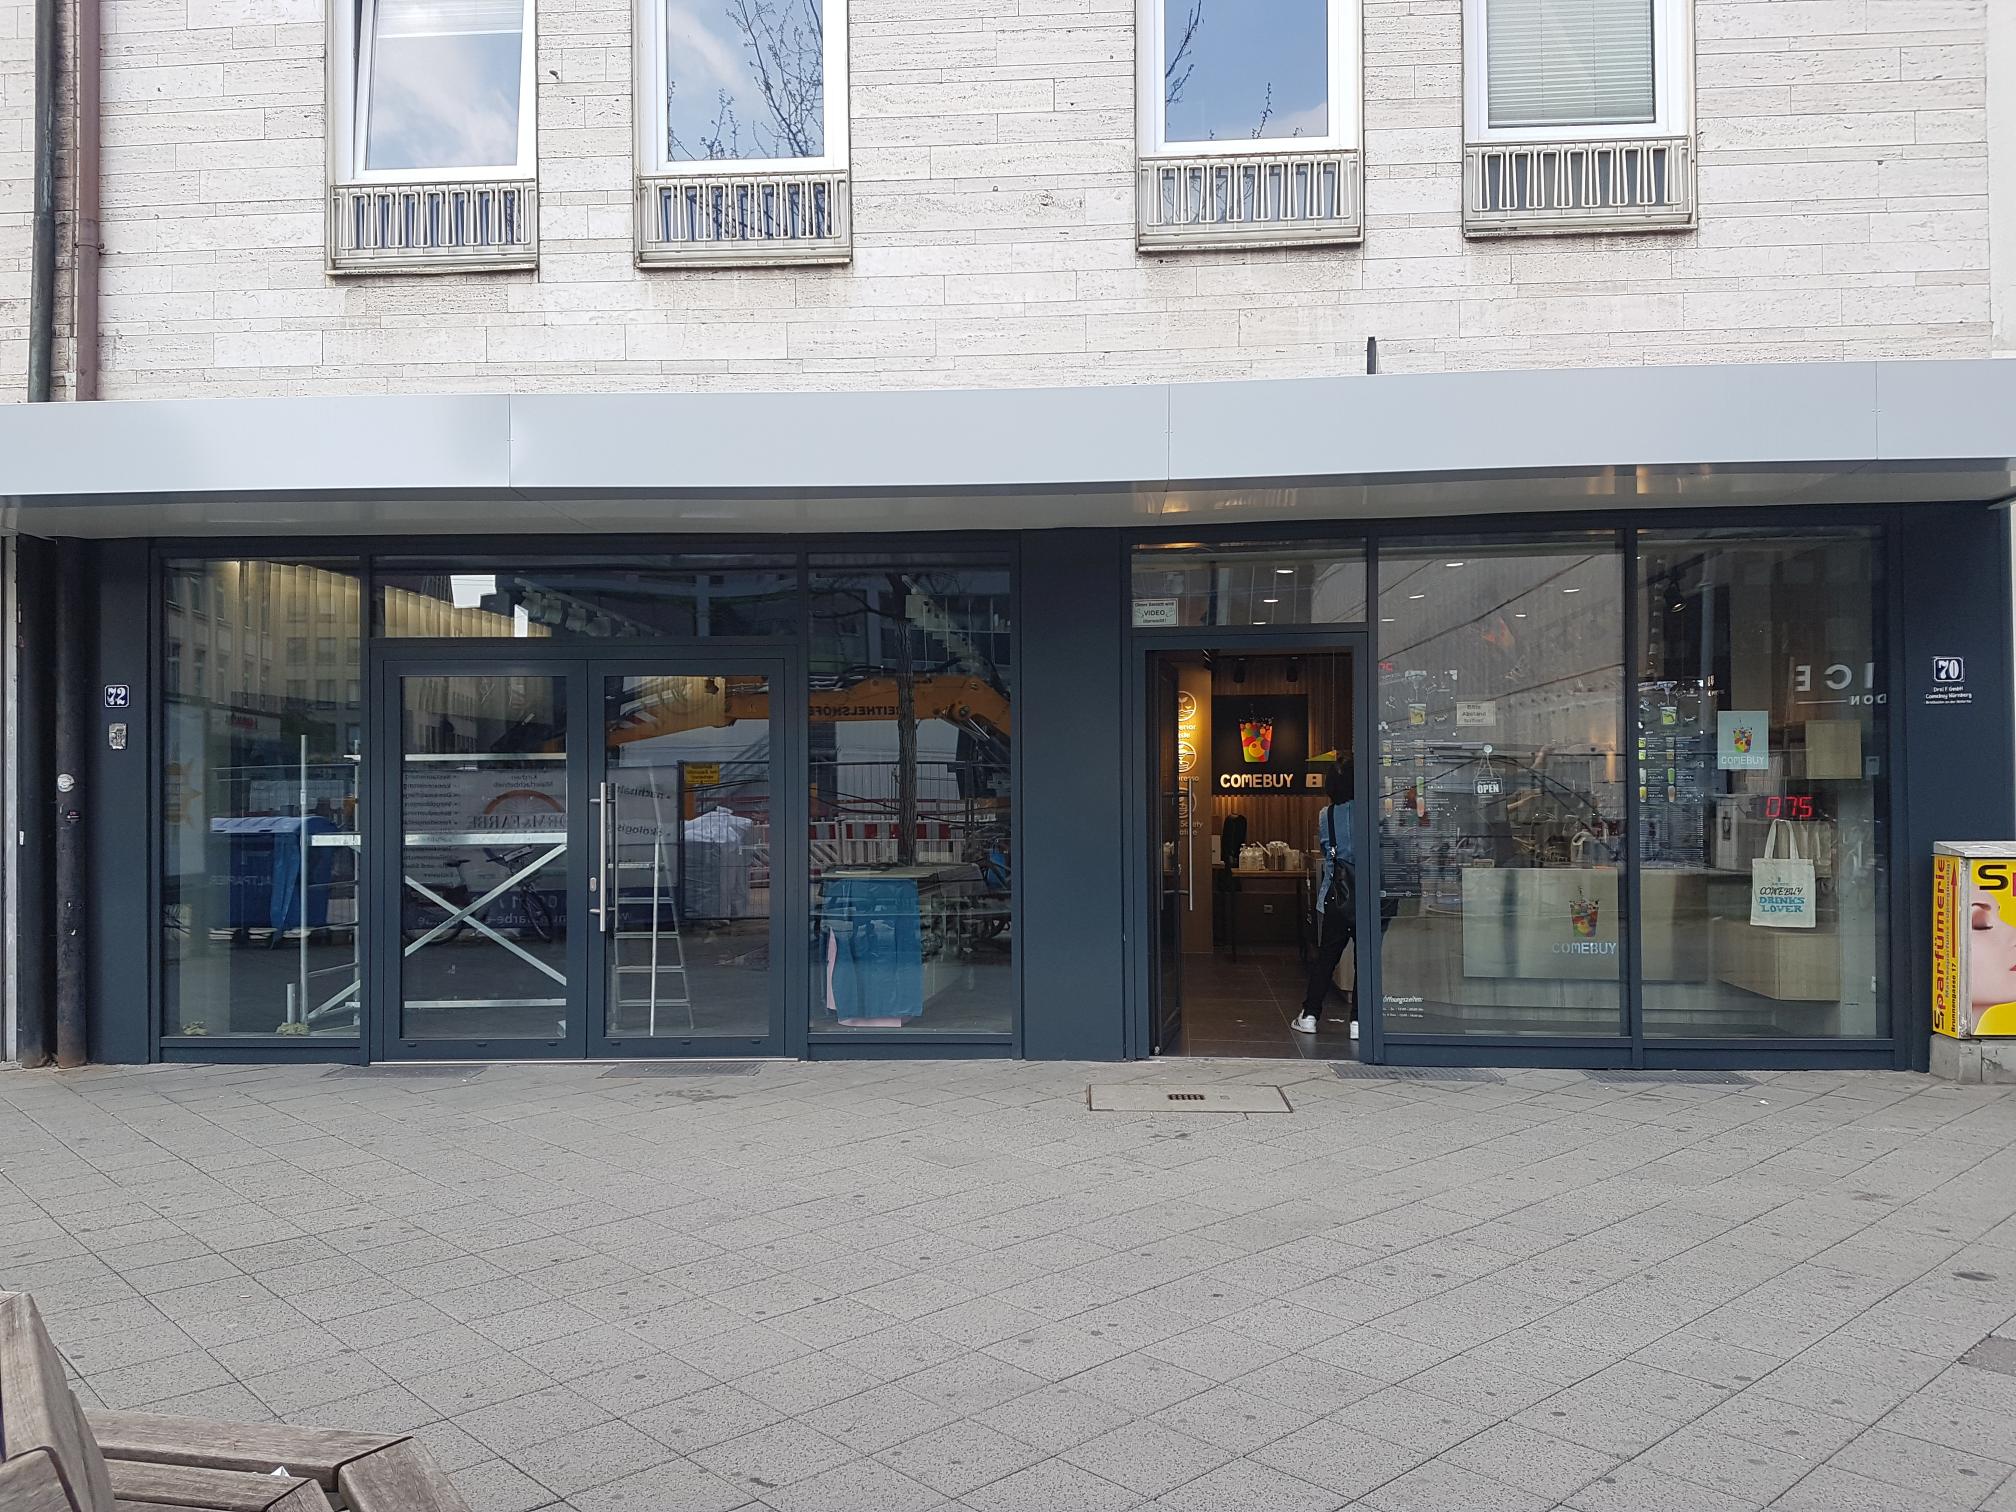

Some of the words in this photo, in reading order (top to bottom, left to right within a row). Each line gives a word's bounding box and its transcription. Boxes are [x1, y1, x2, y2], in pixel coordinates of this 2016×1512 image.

[1938, 660, 1960, 679] 70
[106, 687, 126, 705] 72
[1721, 756, 1765, 765] COMEBUY
[1220, 773, 1294, 788] COMEBUY
[1477, 784, 1500, 793] OPEN
[1765, 796, 1813, 818] 075
[1759, 886, 1803, 896] COMEBUY
[1759, 896, 1805, 905] DRINKS
[1760, 904, 1803, 913] LOVER
[1552, 942, 1617, 954] COMEBUY
[1934, 857, 1946, 1030] Sparfümerie
[1951, 962, 1957, 972] 17
